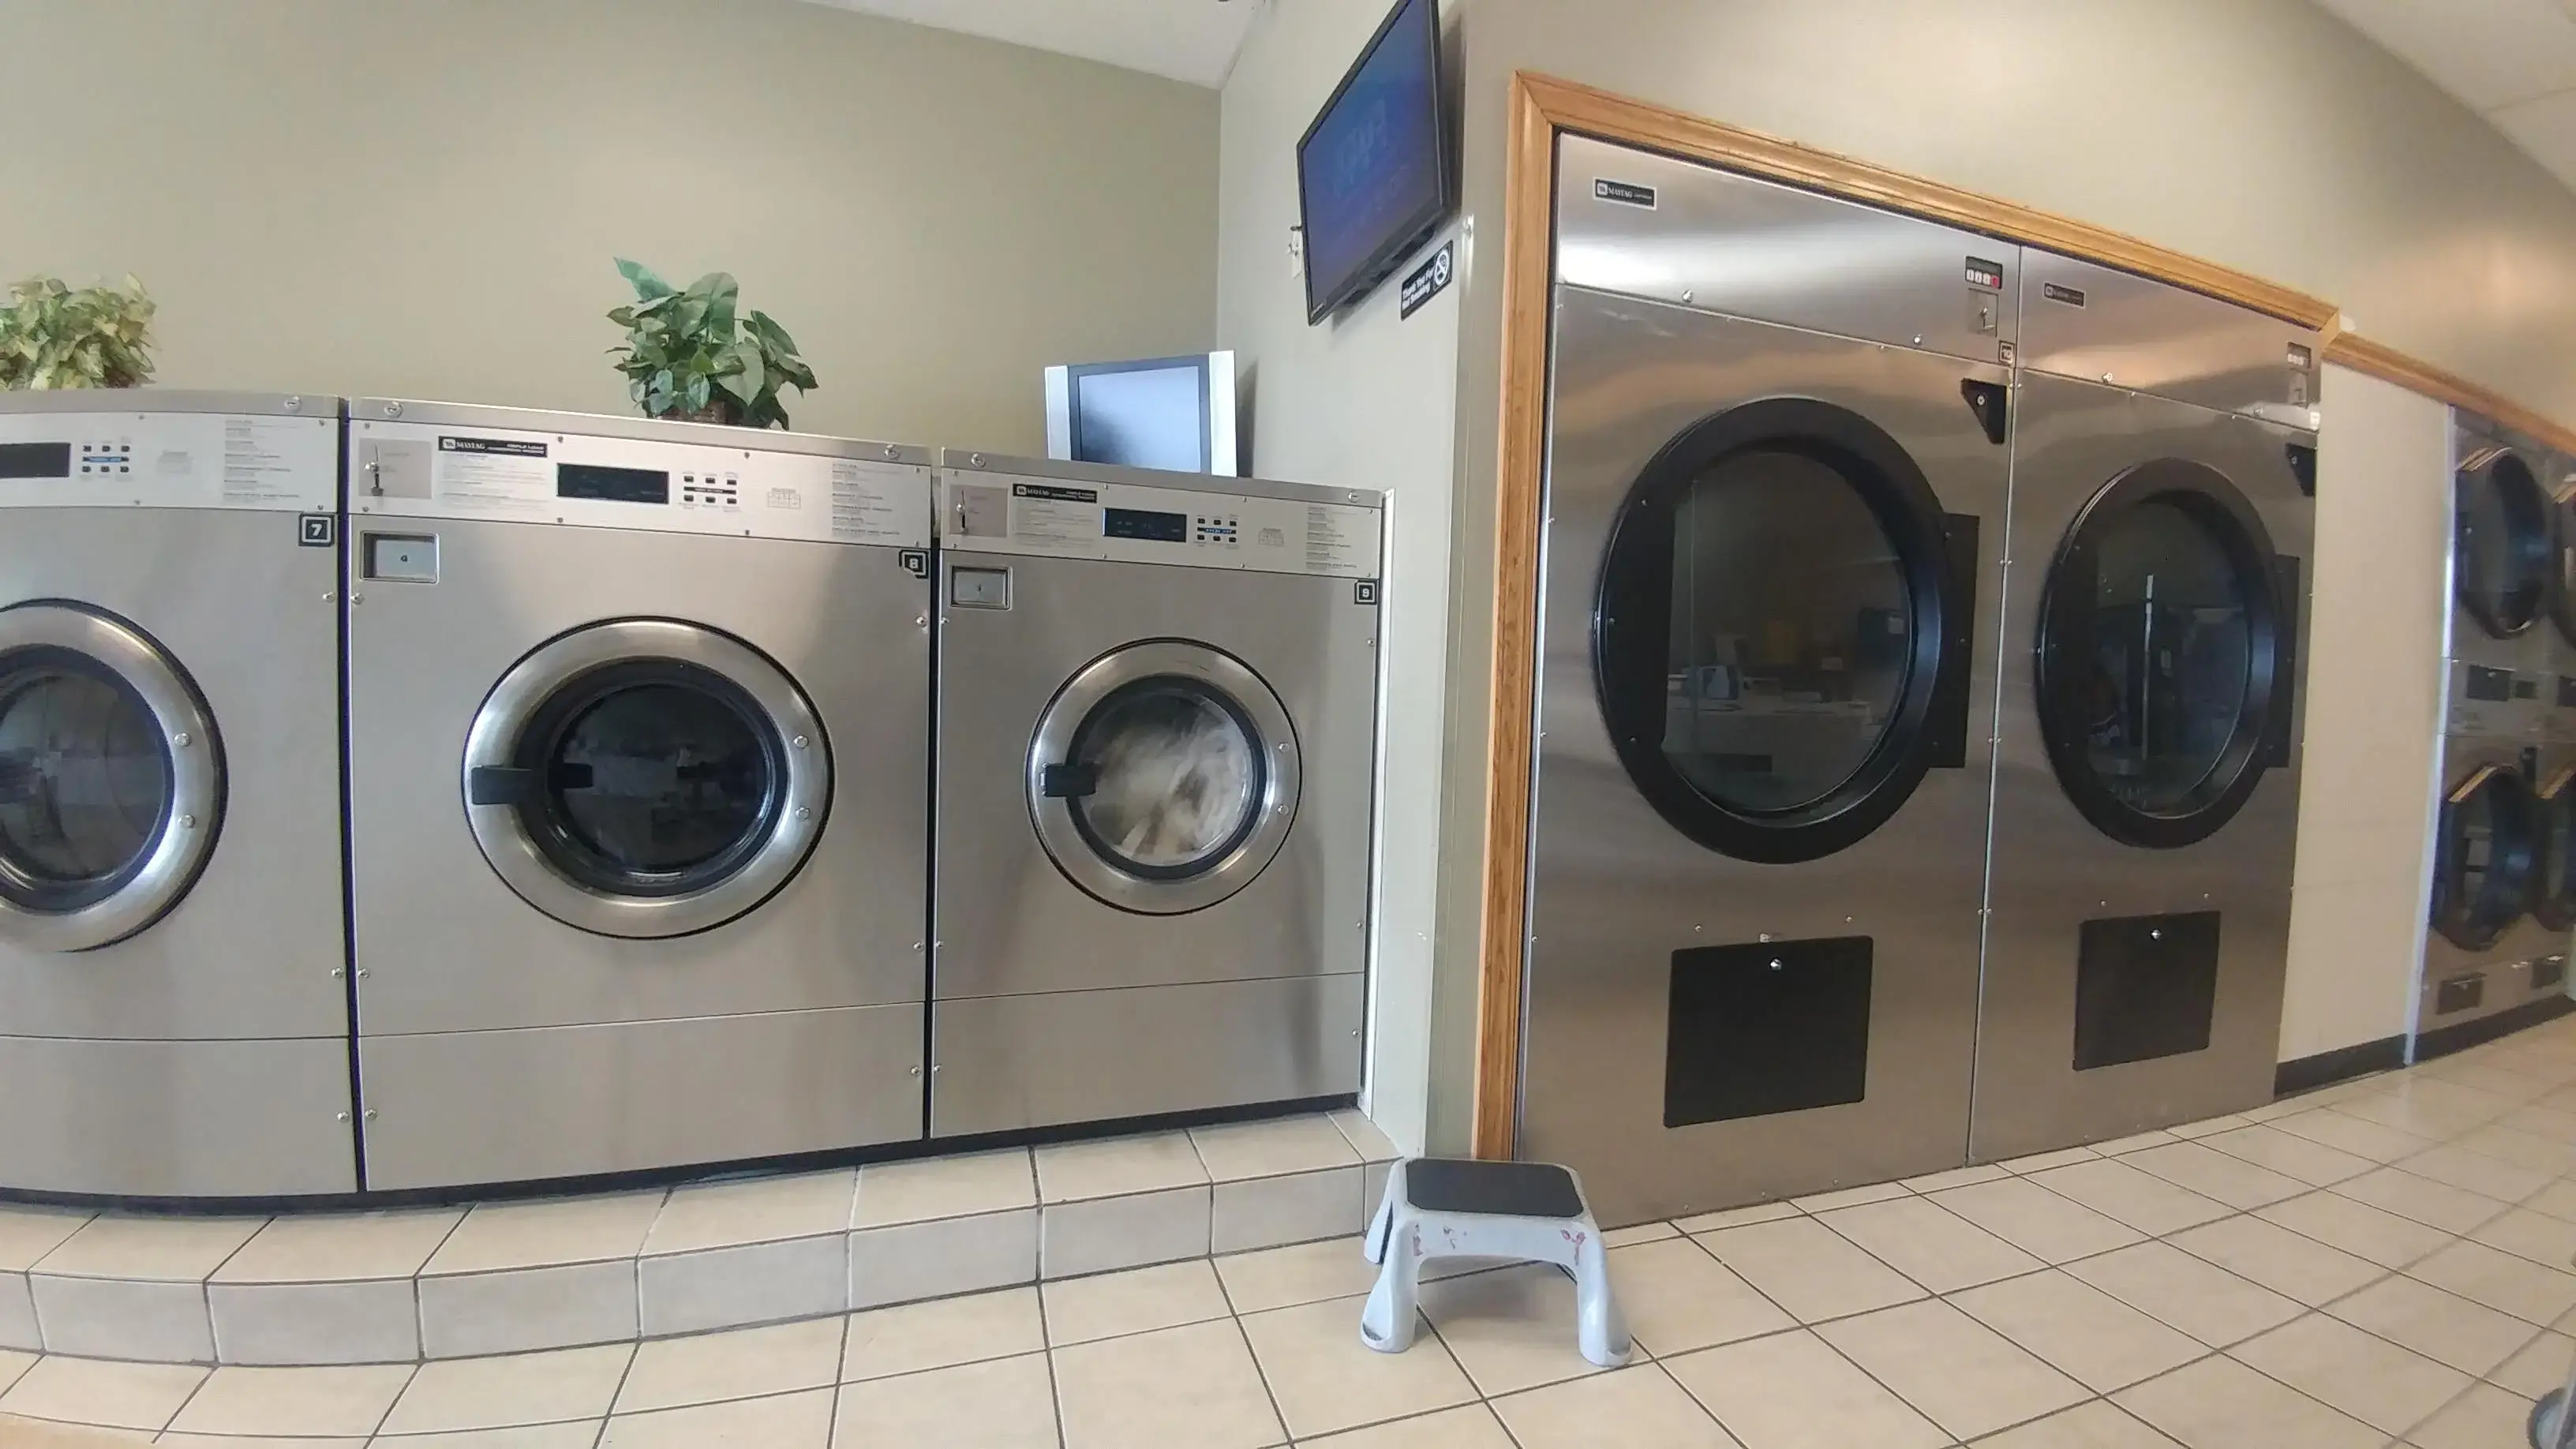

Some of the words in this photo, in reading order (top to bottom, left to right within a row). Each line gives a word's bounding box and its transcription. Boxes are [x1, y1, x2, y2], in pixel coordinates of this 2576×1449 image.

[1608, 185, 1633, 199] MAYTAG
[1410, 280, 1431, 305] Smoking
[310, 523, 323, 537] 7
[1362, 588, 1370, 598] 9
